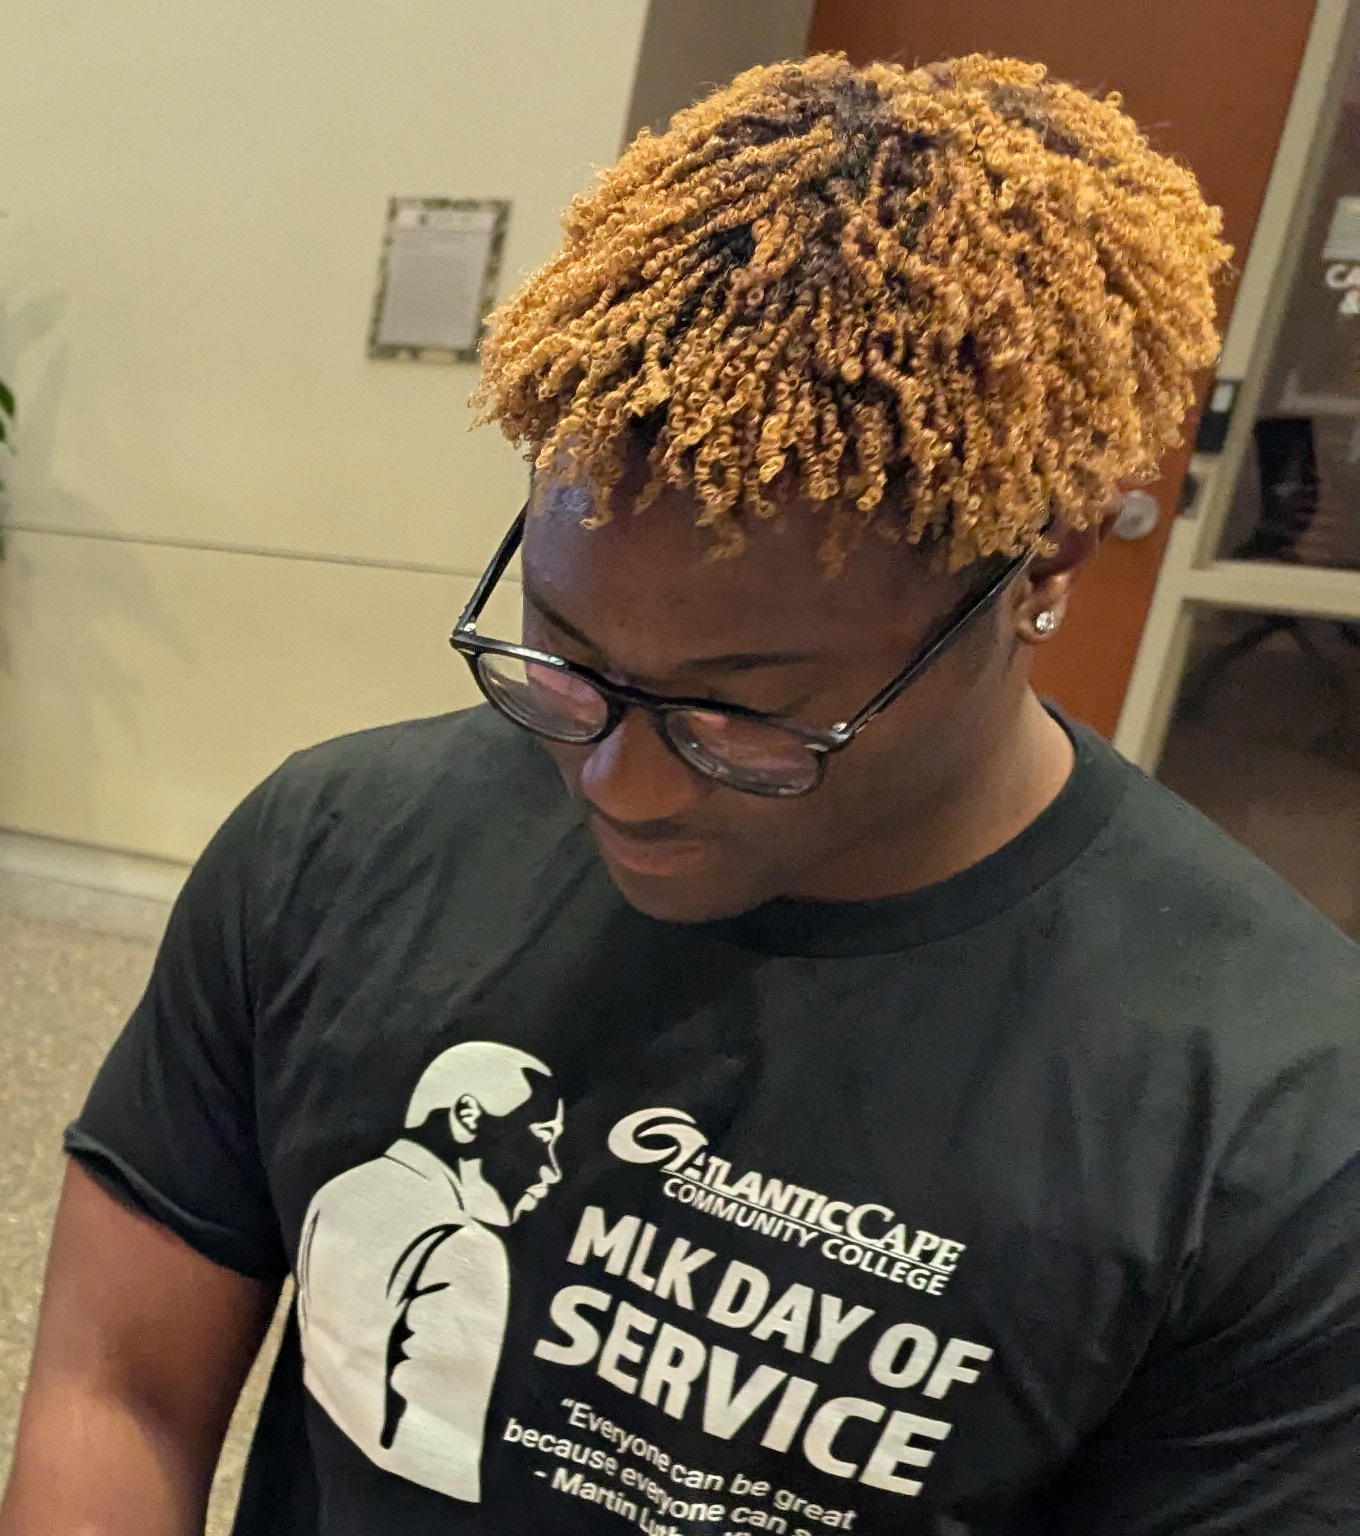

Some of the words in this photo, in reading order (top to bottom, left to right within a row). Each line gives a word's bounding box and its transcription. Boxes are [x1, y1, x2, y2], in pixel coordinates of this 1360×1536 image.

[662, 1177, 819, 1249] COMMUNITY
[820, 1237, 953, 1297] COLLEGE
[565, 1204, 717, 1310] MLK
[707, 1260, 876, 1367] DAY
[868, 1323, 994, 1400] OF
[534, 1284, 953, 1498] SERVICE
[502, 1416, 619, 1477] because
[620, 1467, 727, 1522] everyone
[730, 1505, 789, 1535] can
[550, 1466, 639, 1522] Martin
[559, 1397, 672, 1473] "Everyone
[671, 1463, 726, 1491] can
[729, 1473, 772, 1497] be
[772, 1488, 858, 1530] great
